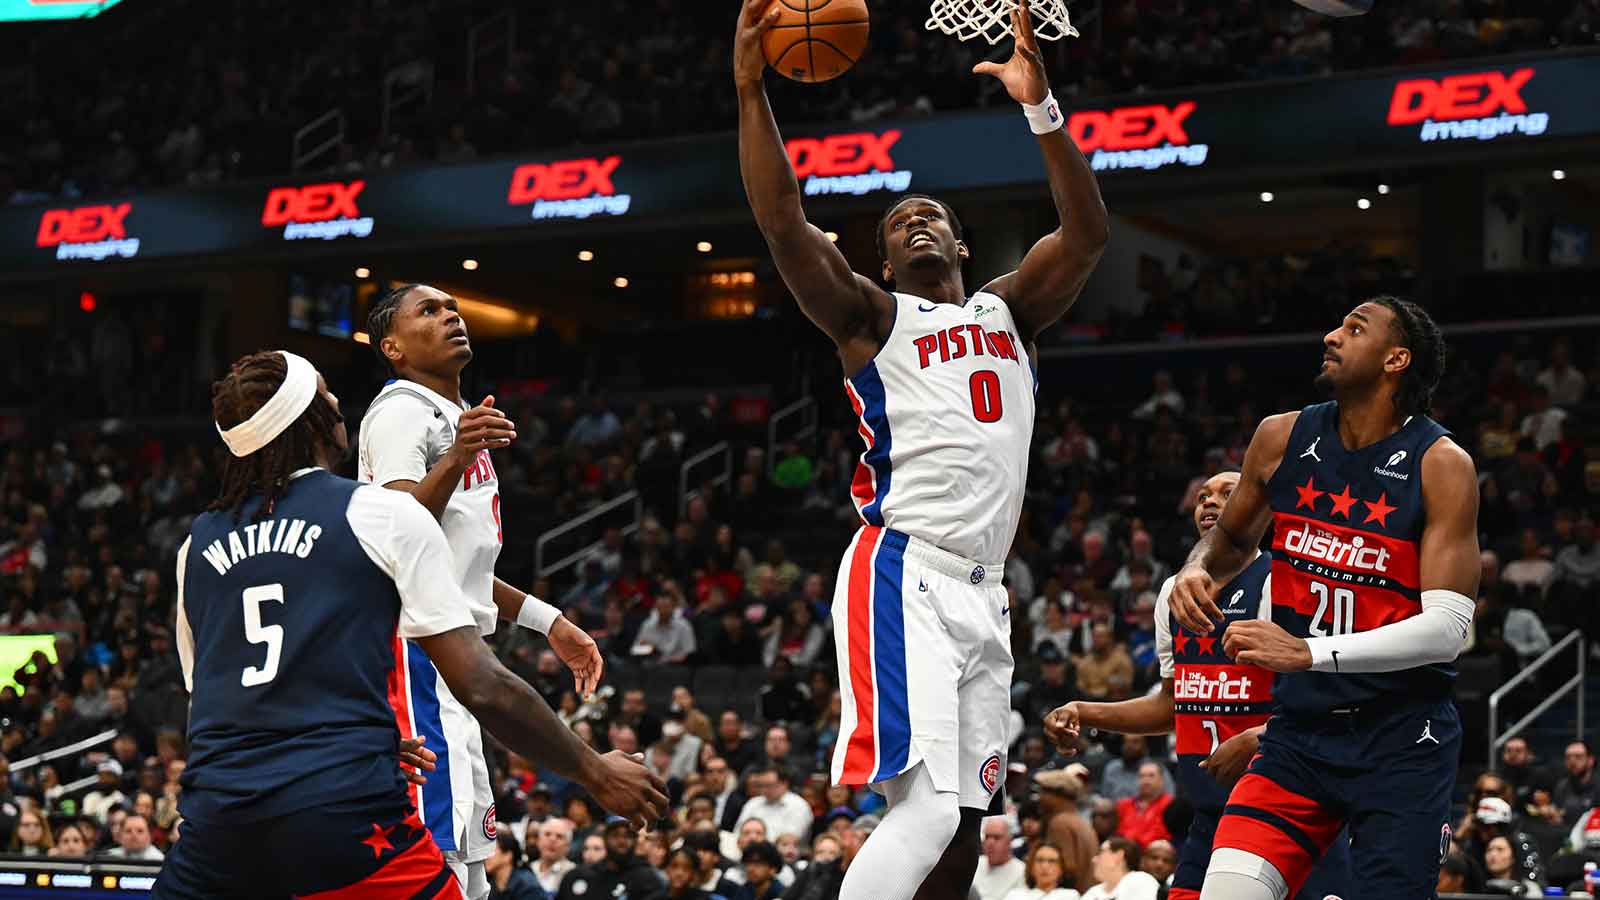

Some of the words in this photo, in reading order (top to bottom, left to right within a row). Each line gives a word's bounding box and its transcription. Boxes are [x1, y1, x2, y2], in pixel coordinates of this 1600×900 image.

[1387, 68, 1535, 125] DEX
[1067, 101, 1196, 153] DEX
[1420, 112, 1549, 142] imaging
[784, 129, 902, 179] DEX
[1091, 143, 1209, 171] imaging
[262, 180, 365, 226] DEX
[508, 156, 622, 204] DEX
[804, 170, 912, 195] imaging
[37, 203, 132, 247] DEX
[283, 217, 374, 240] imaging
[531, 194, 631, 219] imaging
[56, 238, 139, 261] imaging
[968, 370, 1003, 423] 0
[1373, 466, 1409, 480] Robinhood
[202, 518, 323, 576] WATKINS
[1285, 522, 1391, 572] district
[1308, 580, 1354, 638] 20
[241, 583, 285, 687] 5
[1174, 666, 1252, 700] district
